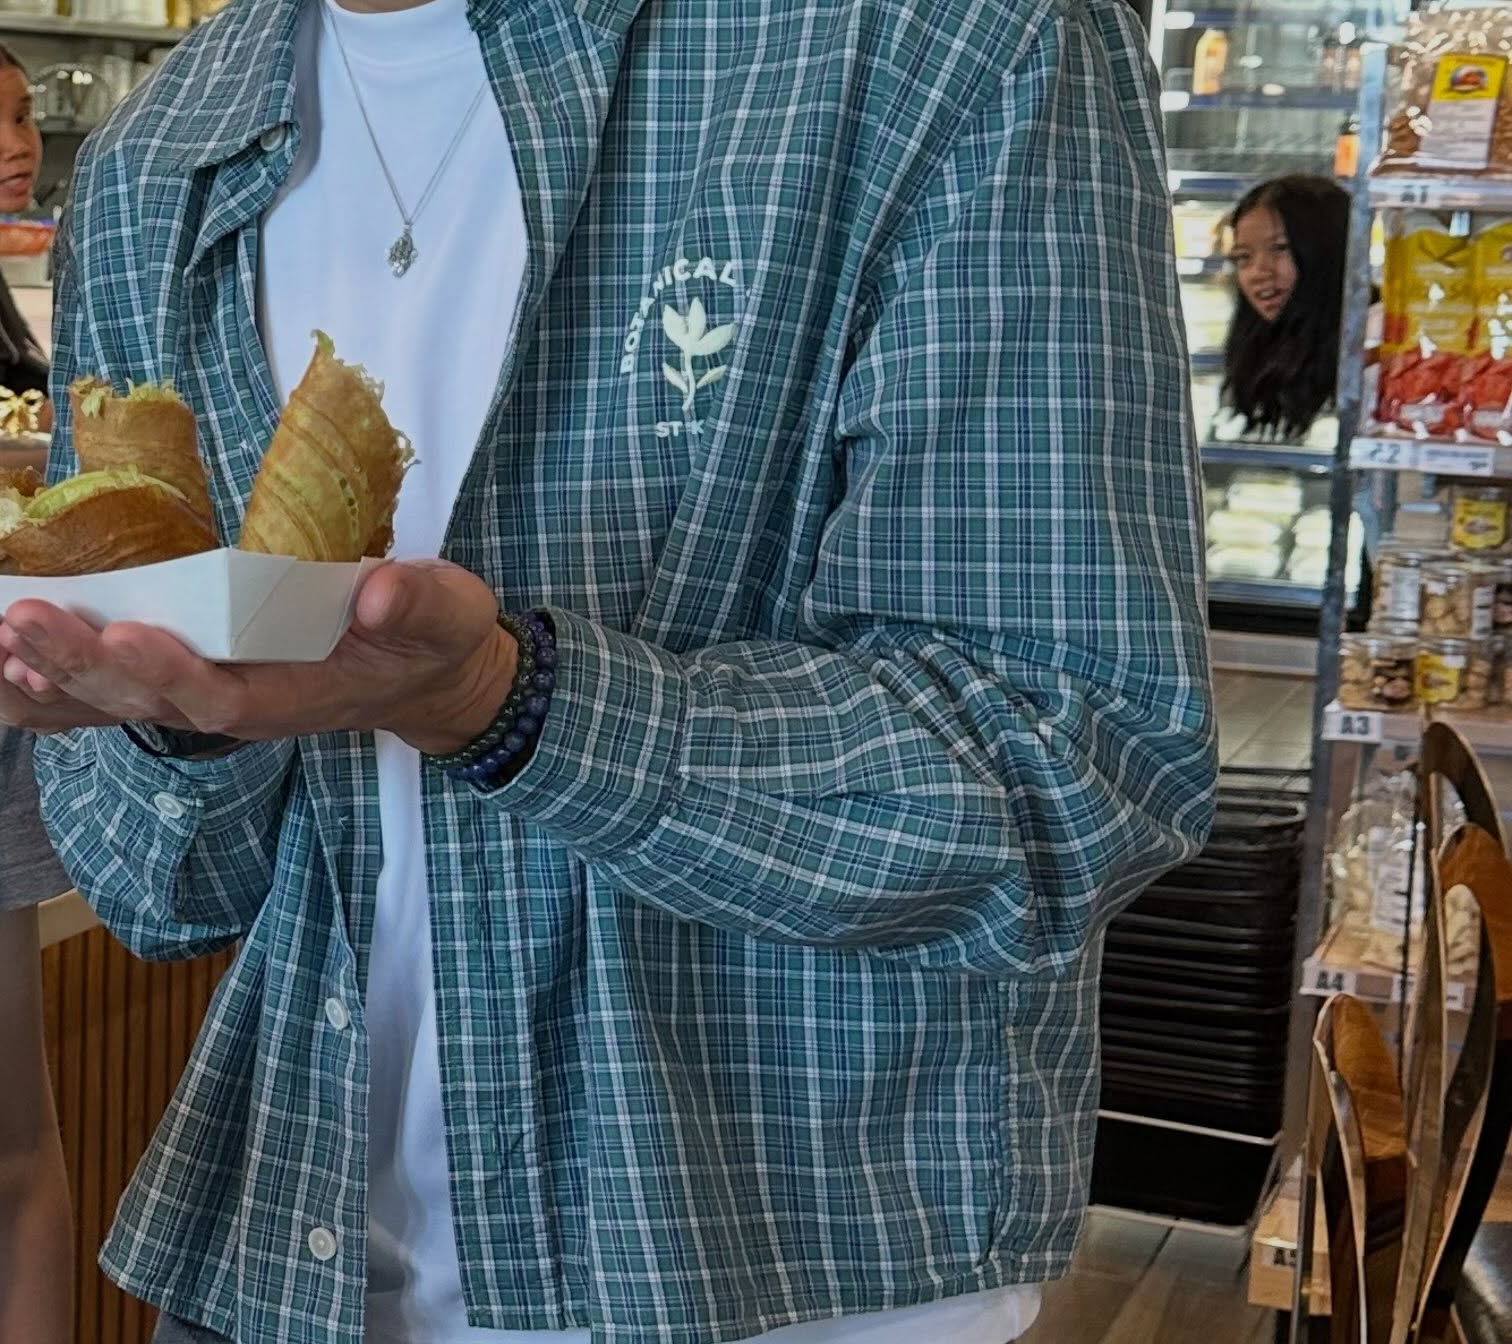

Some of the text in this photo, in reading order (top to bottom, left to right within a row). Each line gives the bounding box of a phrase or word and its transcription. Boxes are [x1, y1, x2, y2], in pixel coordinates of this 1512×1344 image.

[620, 256, 738, 374] BOTANICAL
[1341, 715, 1370, 735] A3
[1316, 970, 1344, 991] A4
